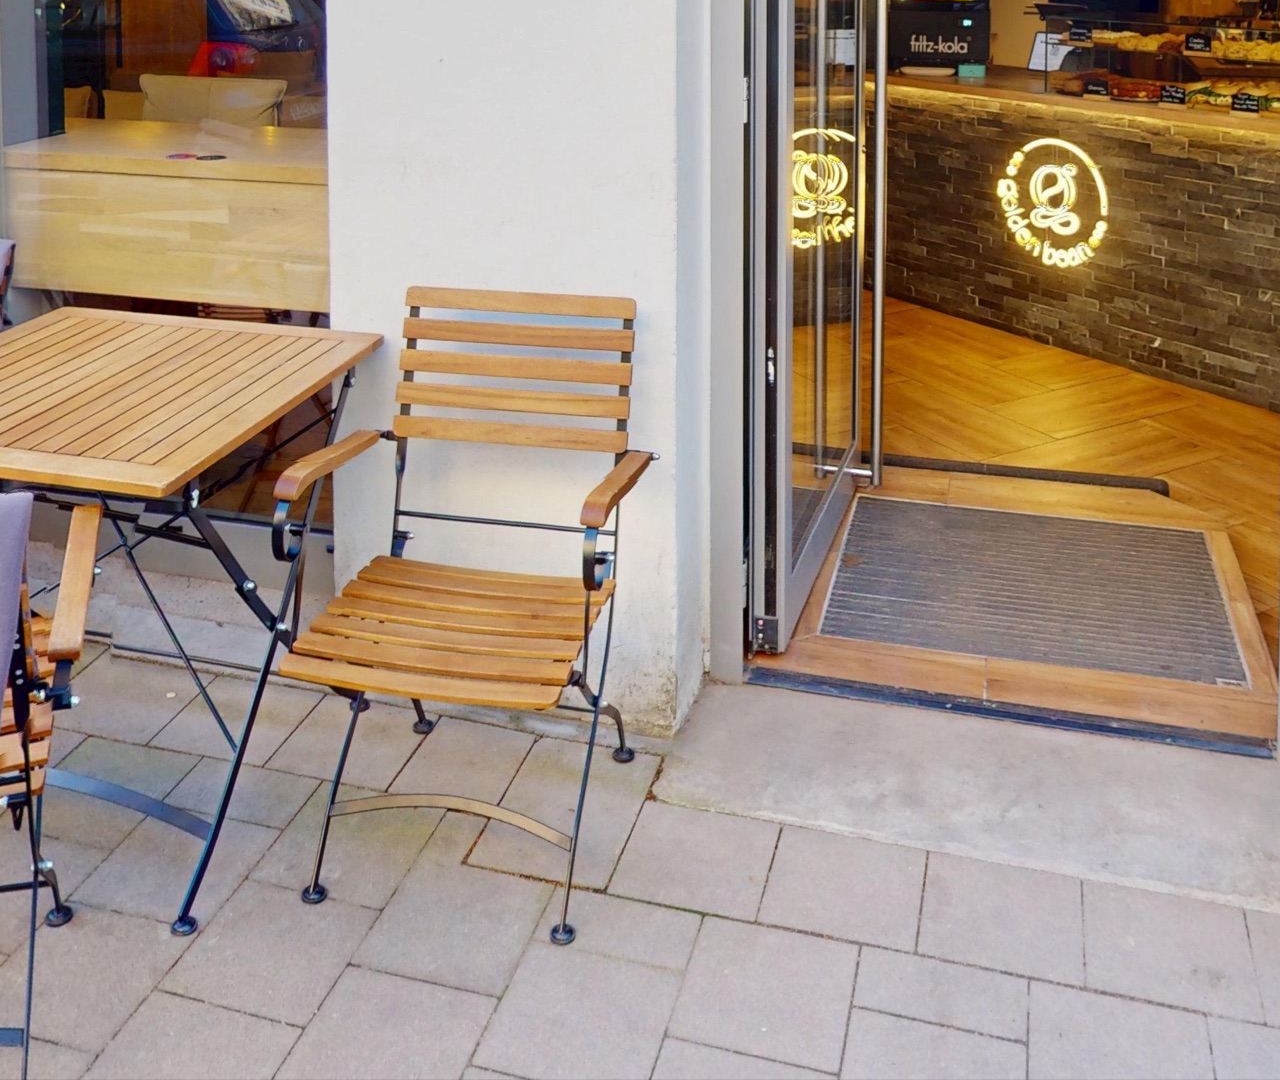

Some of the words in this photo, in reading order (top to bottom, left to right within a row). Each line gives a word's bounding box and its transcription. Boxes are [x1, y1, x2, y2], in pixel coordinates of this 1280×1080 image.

[910, 34, 968, 54] fritz-kola
[997, 178, 1041, 257] golden
[1042, 240, 1095, 268] bean
